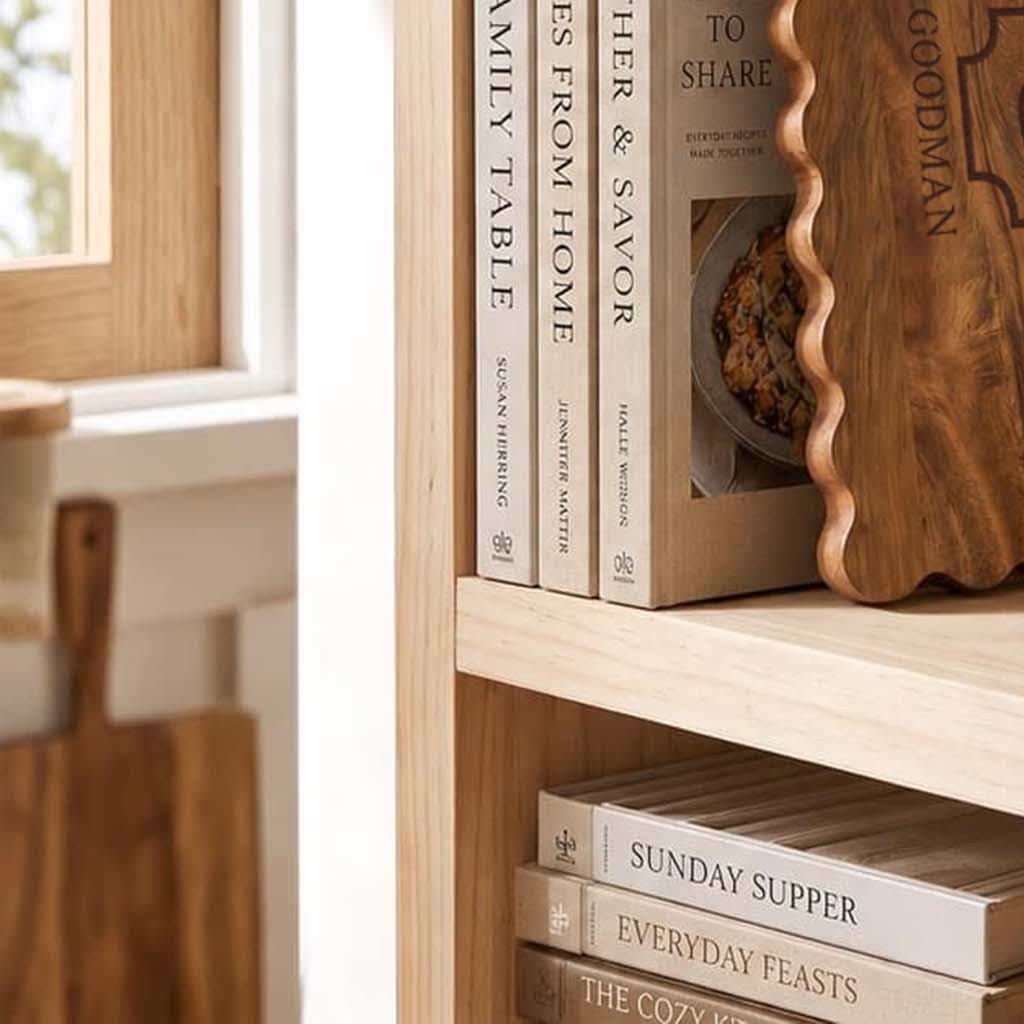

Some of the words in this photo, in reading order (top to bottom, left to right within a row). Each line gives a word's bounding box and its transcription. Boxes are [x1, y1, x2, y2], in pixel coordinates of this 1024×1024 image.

[707, 15, 744, 42] TO
[681, 59, 773, 89] SHARE
[551, 66, 574, 189] FROM
[612, 124, 634, 156] &
[907, 8, 957, 237] GOODMAN
[490, 157, 514, 310] TABLE
[552, 209, 574, 343] HOME
[613, 178, 634, 326] SAVOR
[496, 357, 508, 418] SUSAN
[630, 841, 744, 894] SUNDAY
[751, 872, 858, 925] SUPPER
[580, 976, 630, 1014] THE
[637, 993, 706, 1024] COZY
[617, 914, 755, 975] EVERYDAY
[761, 954, 859, 1004] FEASTS
